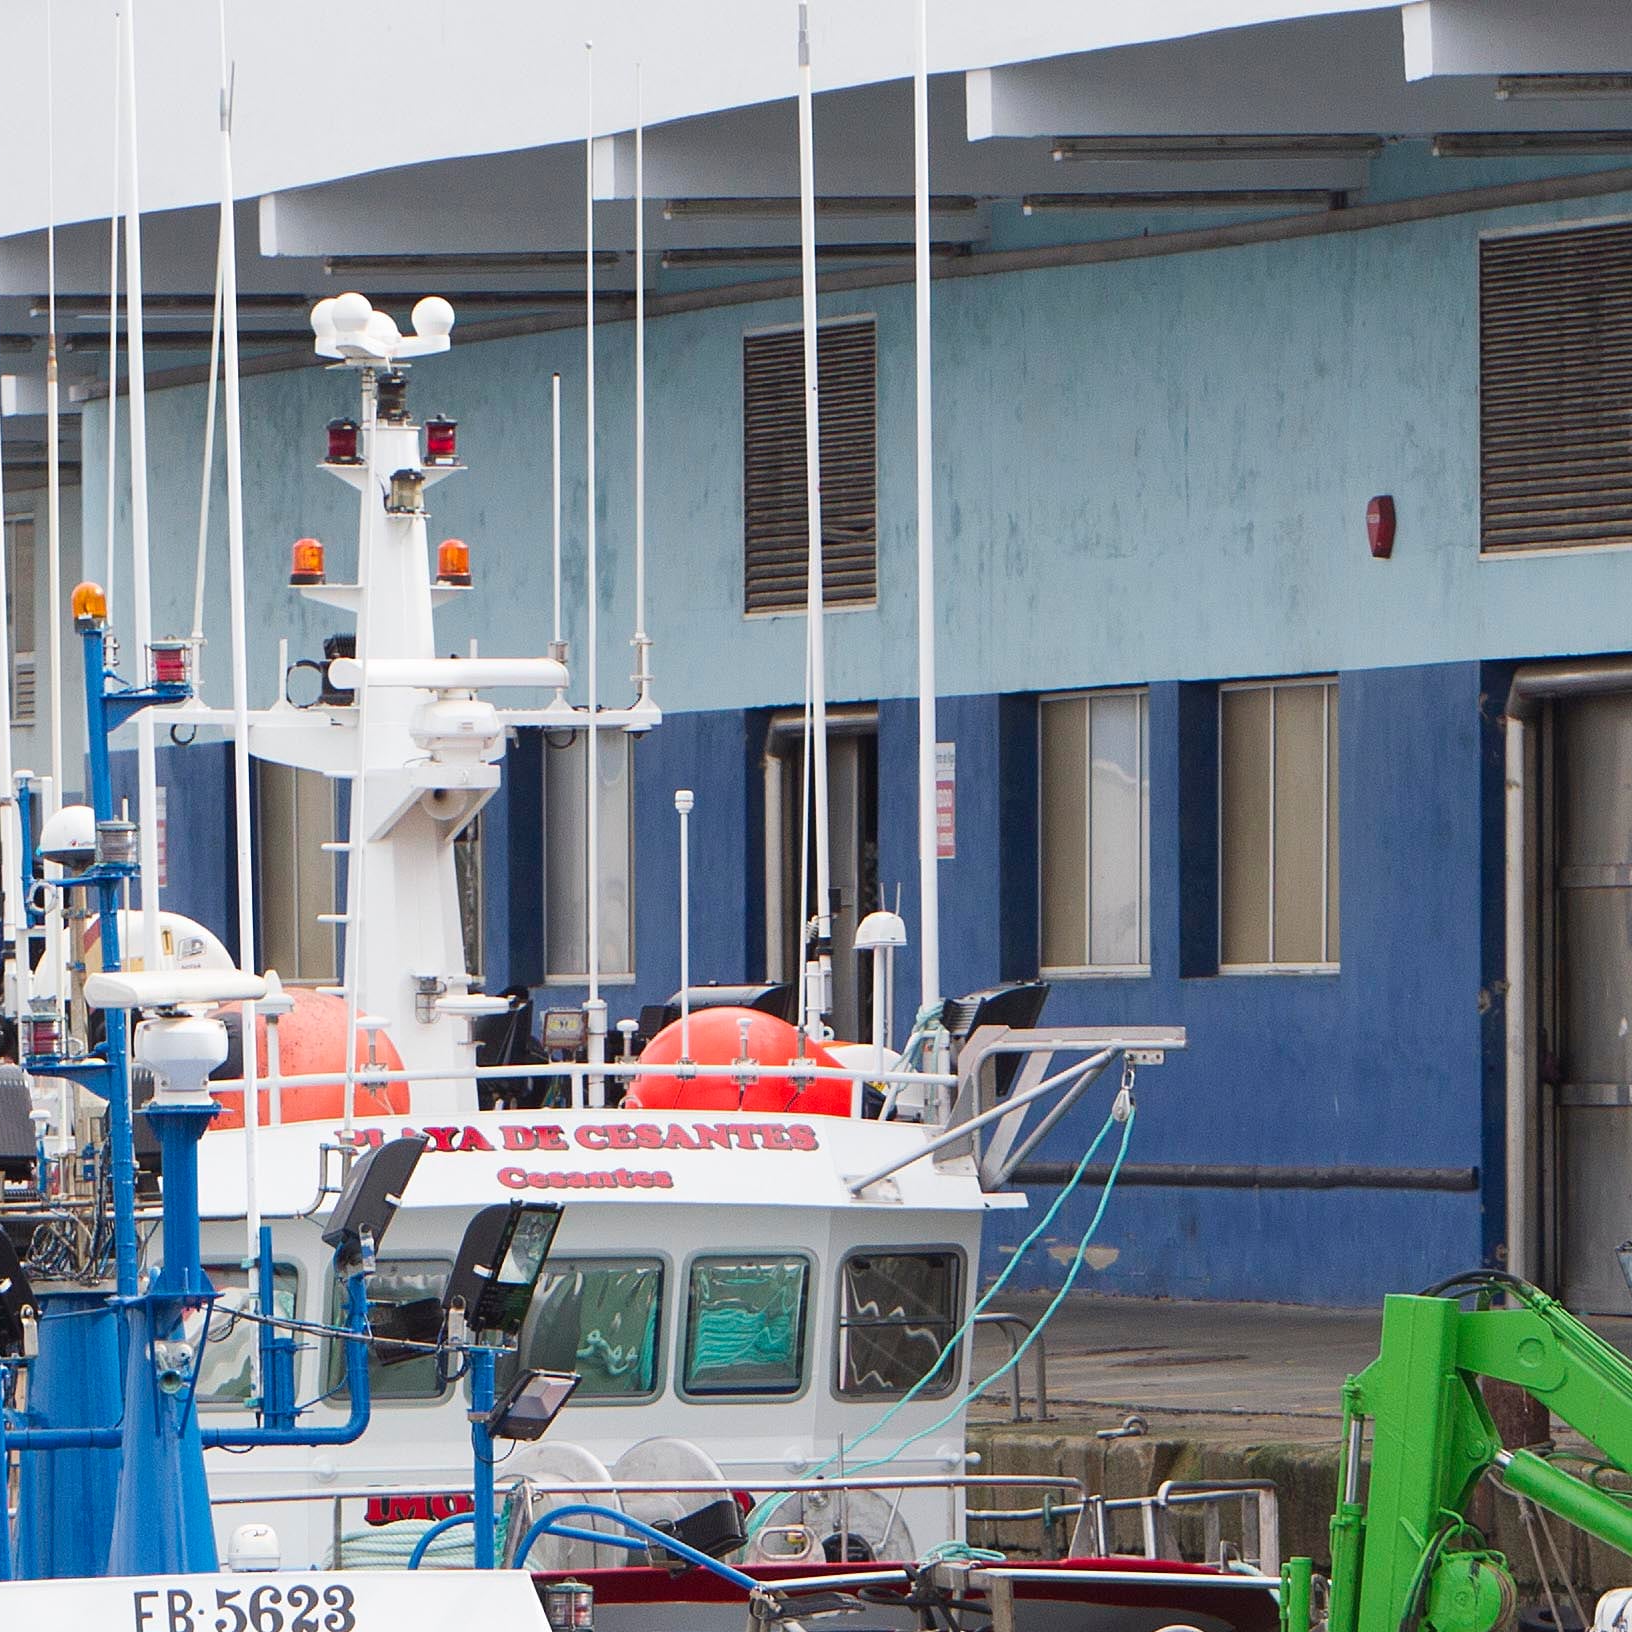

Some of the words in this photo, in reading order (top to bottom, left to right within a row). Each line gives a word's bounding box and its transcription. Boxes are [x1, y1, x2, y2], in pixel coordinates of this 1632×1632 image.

[501, 1124, 569, 1152] DE
[574, 1122, 819, 1152] CESANTES
[497, 1167, 674, 1190] Cesantes
